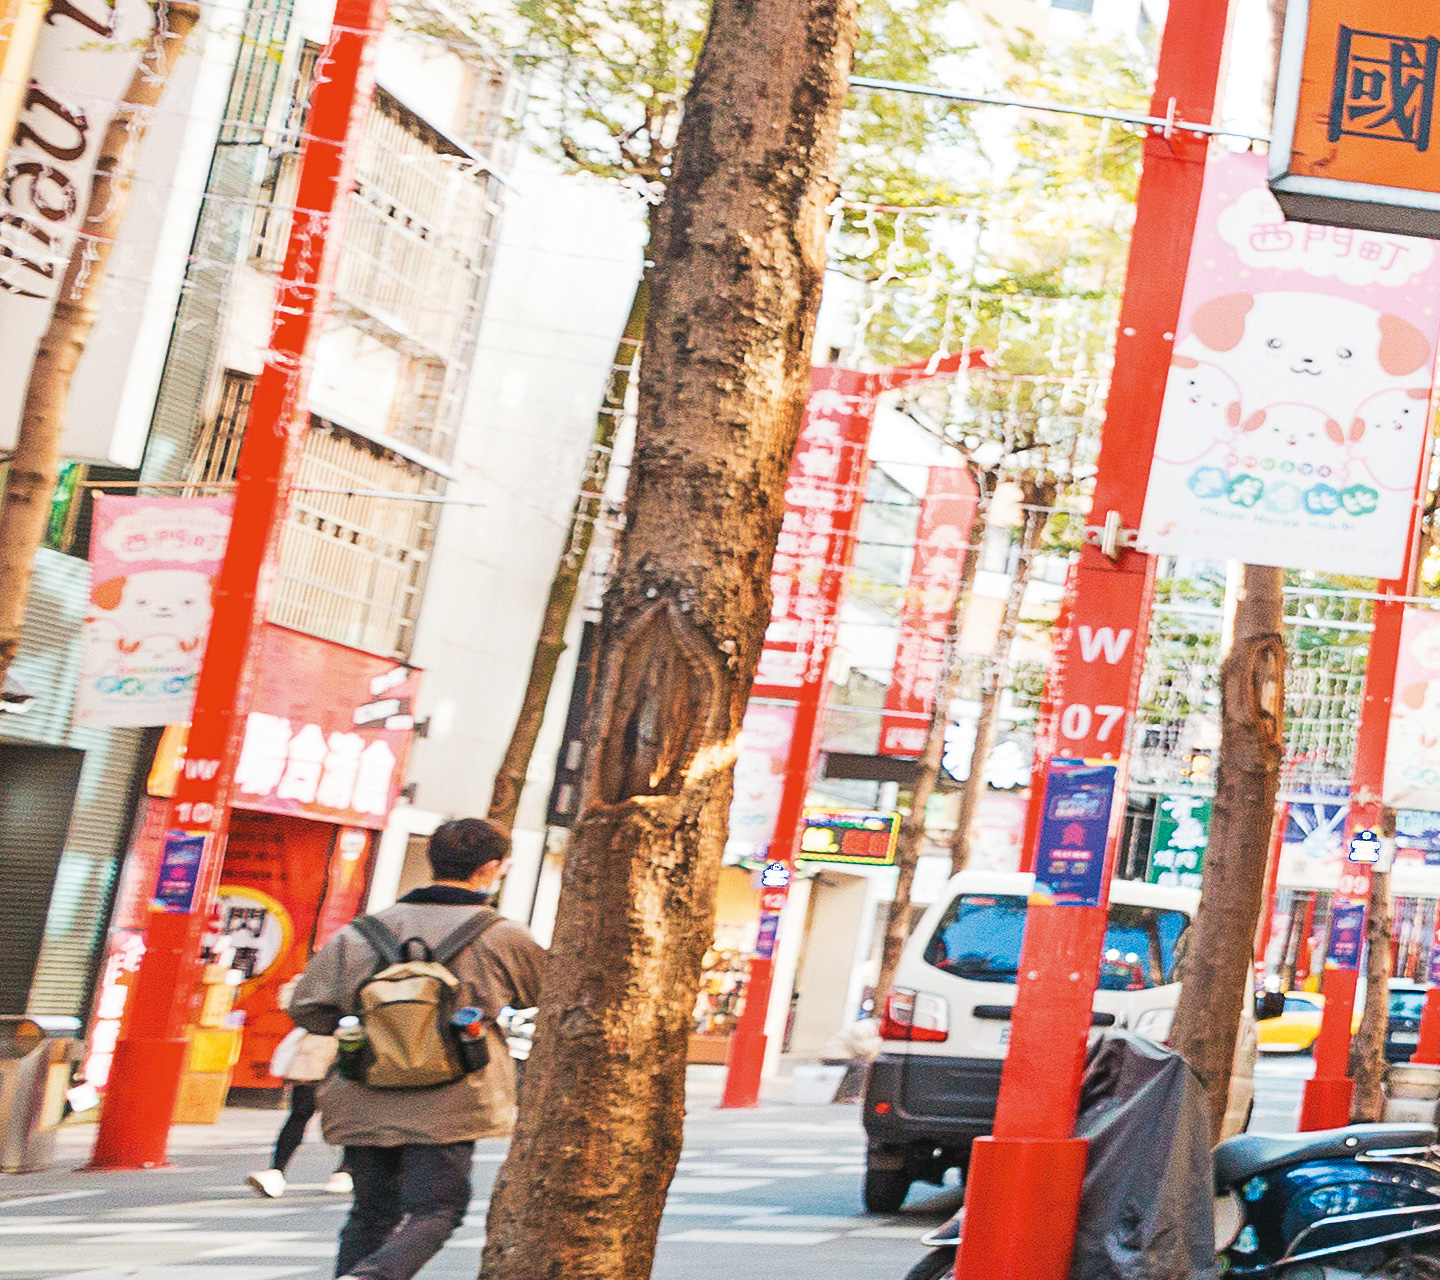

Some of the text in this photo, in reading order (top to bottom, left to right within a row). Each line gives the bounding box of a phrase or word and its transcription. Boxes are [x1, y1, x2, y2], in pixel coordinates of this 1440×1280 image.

[1250, 222, 1411, 271] 西門町
[1077, 624, 1133, 665] W
[1060, 703, 1125, 742] 07
